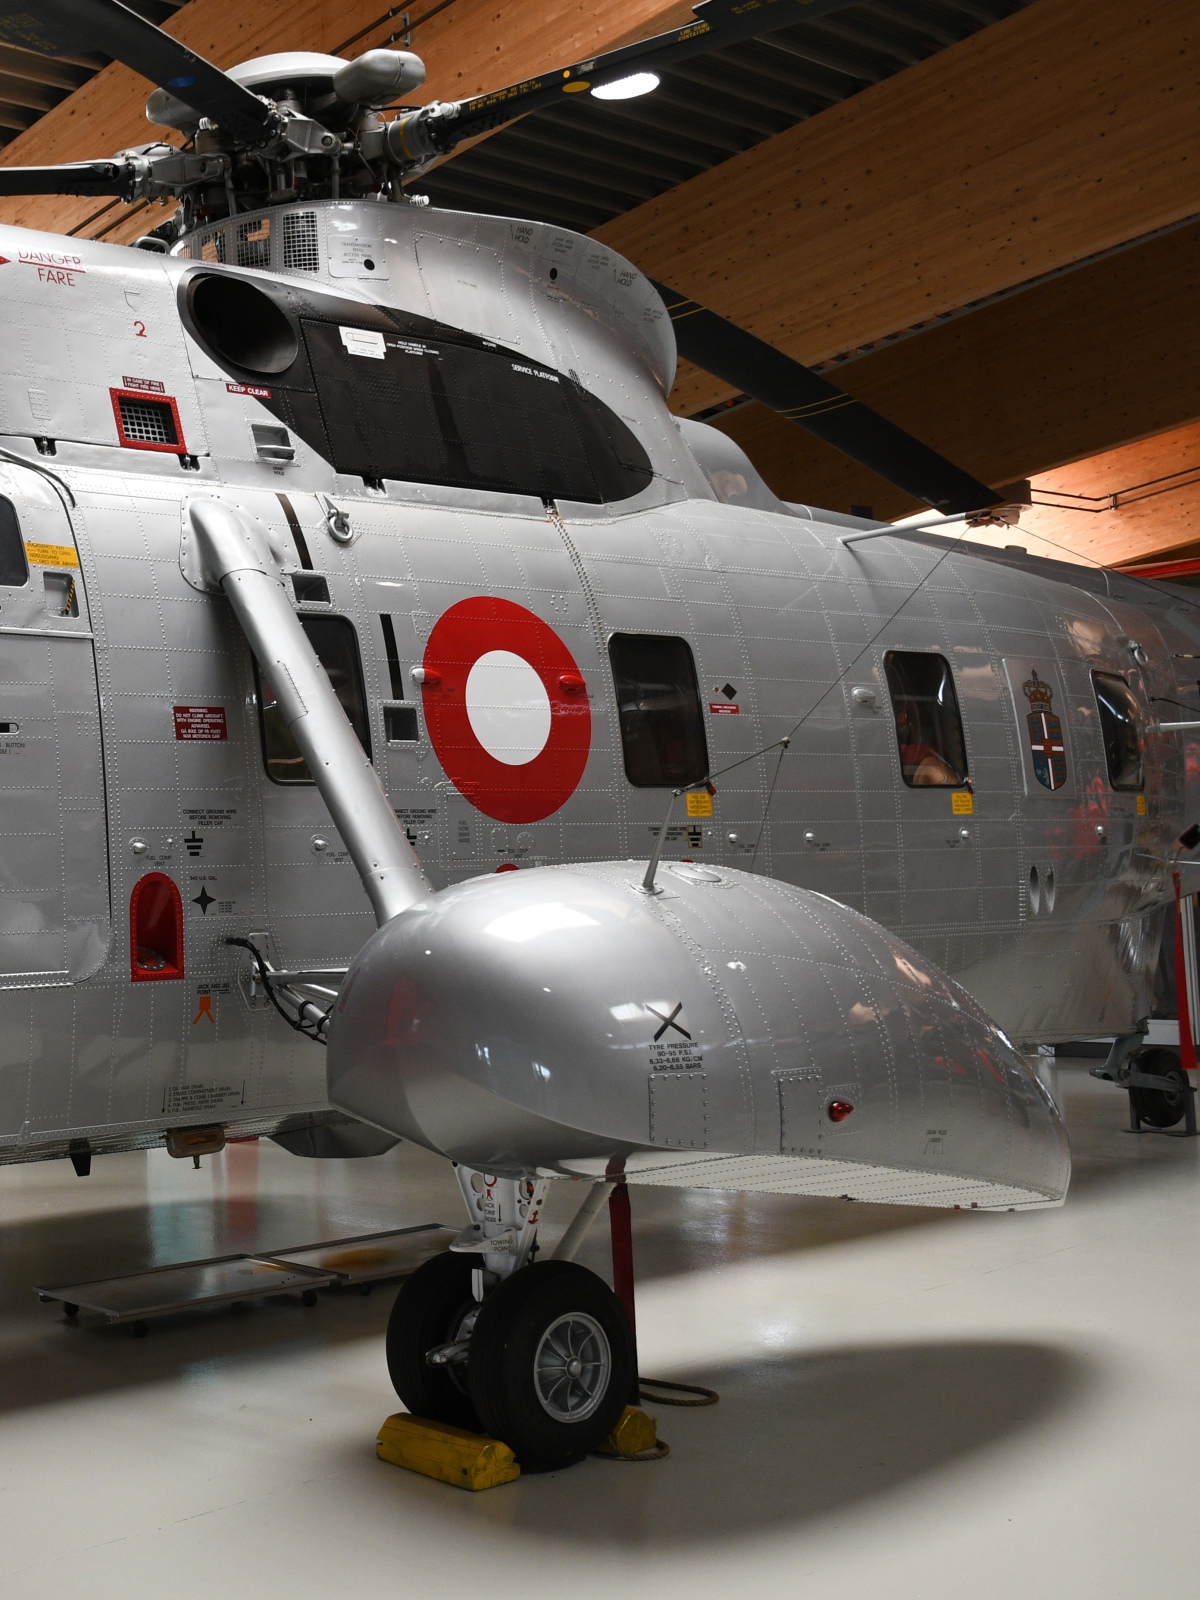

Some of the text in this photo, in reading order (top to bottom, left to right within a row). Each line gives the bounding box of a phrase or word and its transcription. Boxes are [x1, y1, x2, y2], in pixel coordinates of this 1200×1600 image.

[515, 235, 529, 243] HOLD
[517, 226, 533, 235] HAND
[18, 248, 82, 267] DANGER
[37, 268, 76, 286] FARE
[133, 320, 147, 337] 2
[511, 363, 560, 384] SERVICE PLATFORM
[228, 384, 269, 396] KEEP CLEAR
